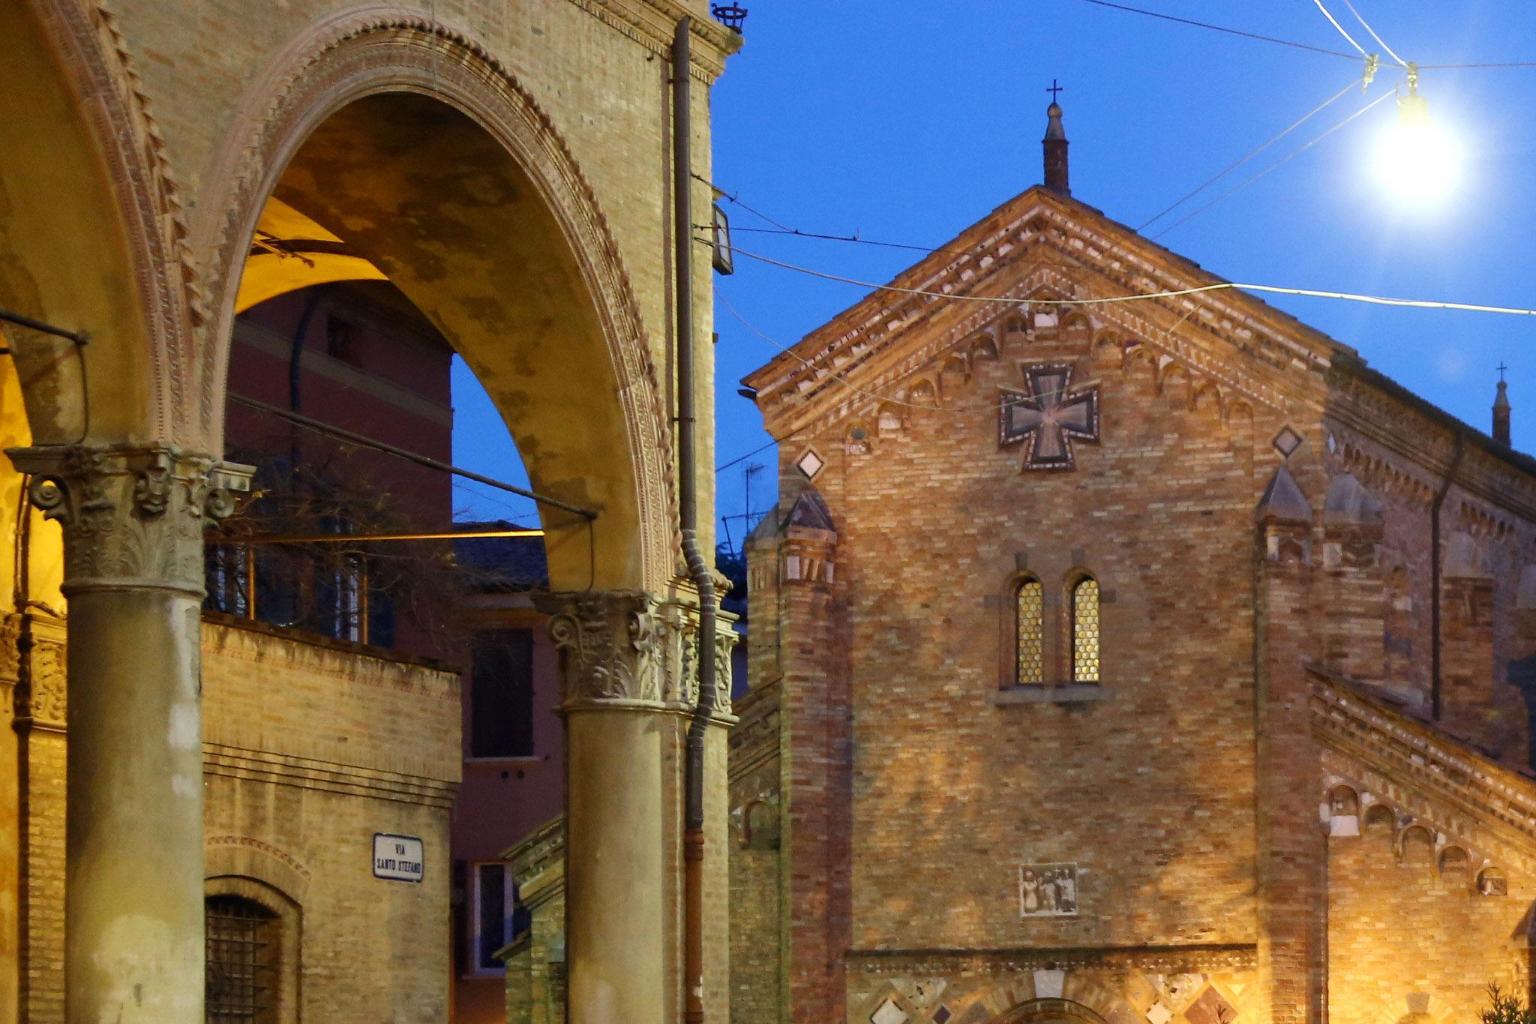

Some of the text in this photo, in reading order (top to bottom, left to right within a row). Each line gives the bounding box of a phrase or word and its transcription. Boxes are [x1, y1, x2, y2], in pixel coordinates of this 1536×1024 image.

[395, 844, 405, 855] VIA
[377, 858, 421, 874] SANTO STEFANO
